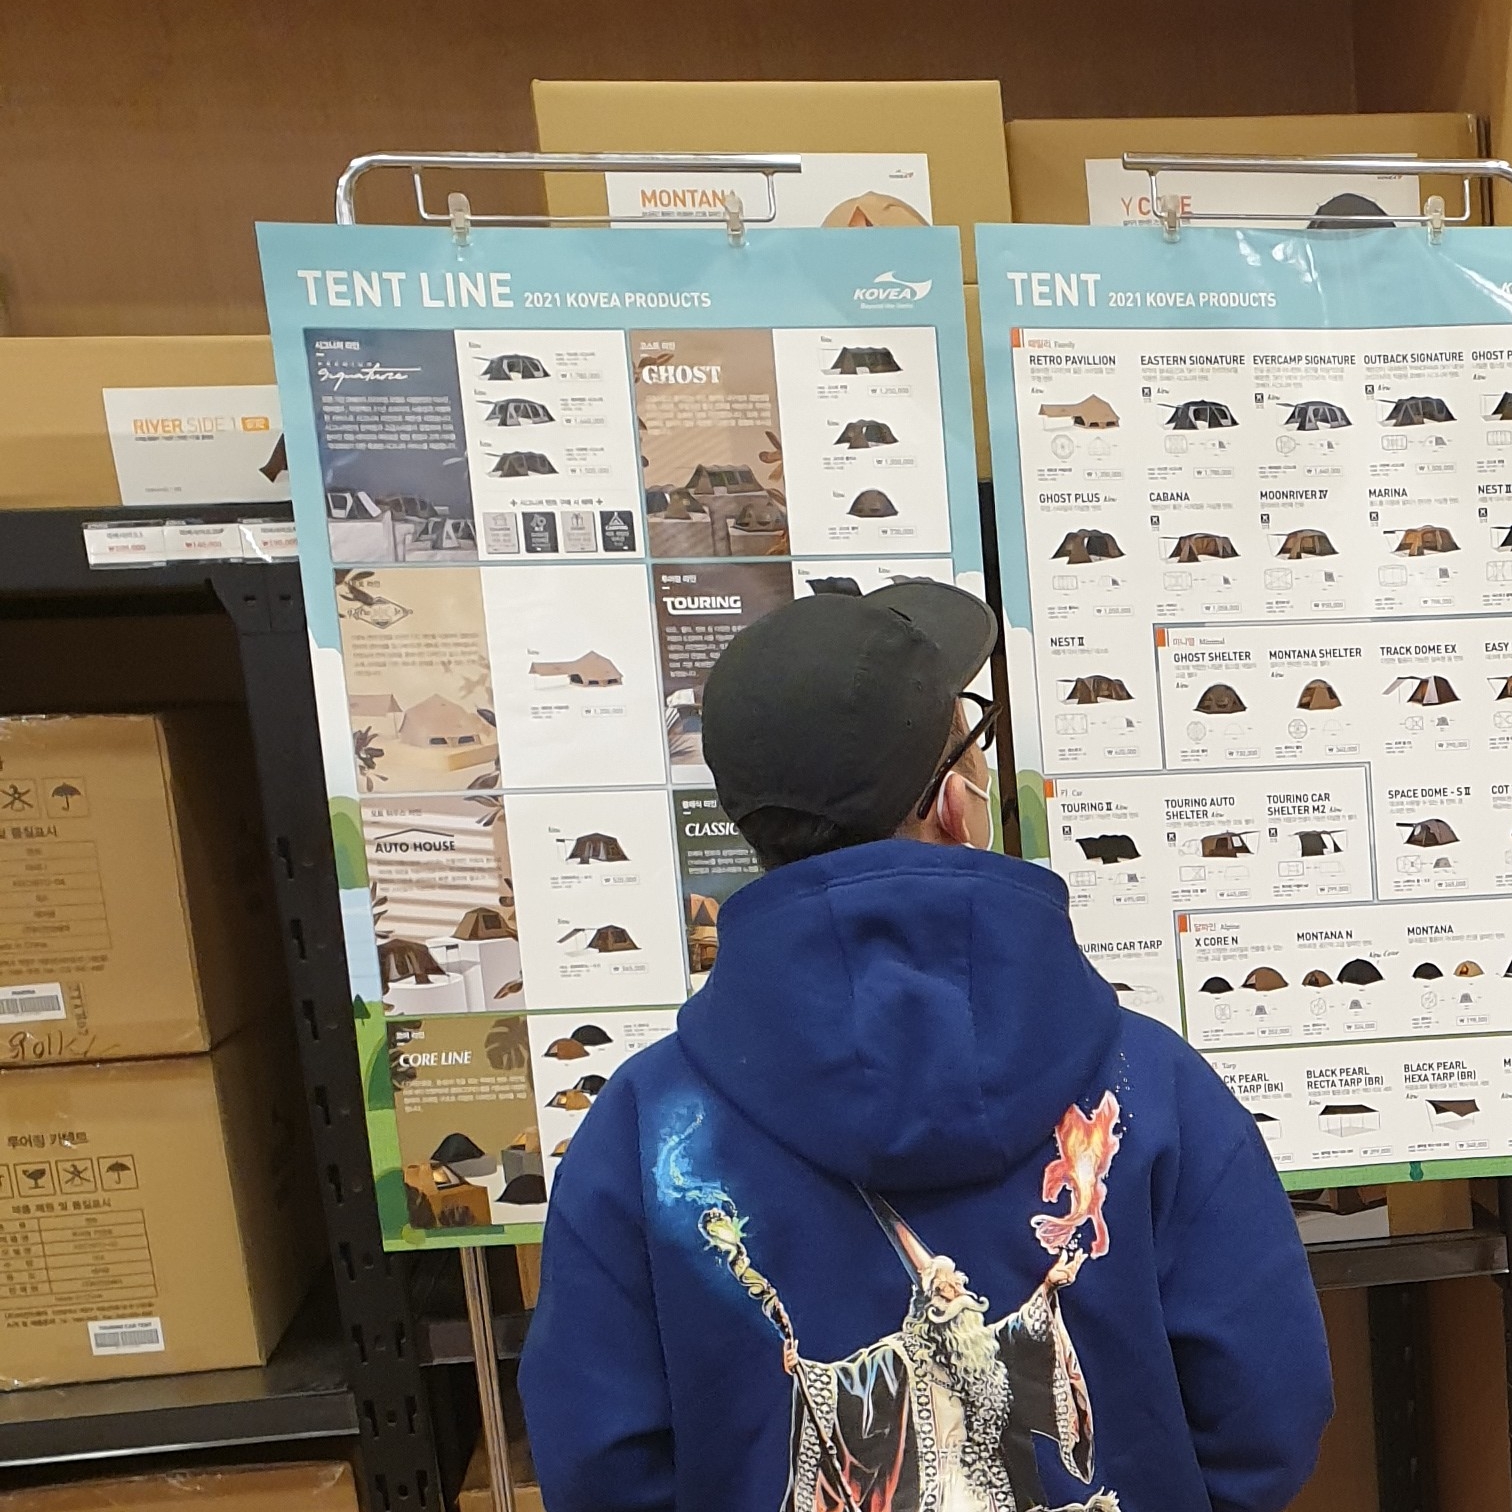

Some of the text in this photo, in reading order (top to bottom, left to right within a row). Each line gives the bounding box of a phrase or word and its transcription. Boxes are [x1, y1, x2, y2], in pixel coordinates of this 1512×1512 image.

[1121, 197, 1133, 215] Y
[297, 269, 712, 309] TENT LINE 2021 KOVEA PRODUCTS
[854, 287, 912, 301] KOVEA
[1007, 272, 1277, 308] TENT 2021 KOVEA PRODUCTS
[1029, 355, 1116, 366] RETRO PAVILLION
[1140, 354, 1246, 367] EASTERN SIGNATURE
[1252, 354, 1357, 367] EVERCAMP SIGNATURE
[1363, 351, 1464, 365] OUTBACK SIGNATURE
[1471, 349, 1504, 361] GHOST
[642, 365, 723, 385] GHOST
[133, 418, 184, 434] RIVER
[186, 417, 227, 433] SIDE
[1259, 489, 1318, 501] MOONRIVER
[1368, 488, 1408, 499] MARINA
[1477, 484, 1504, 495] NEST
[1039, 492, 1101, 504] GHOST PLUS
[1149, 491, 1190, 502] CABANA
[662, 595, 742, 615] TOURING
[1050, 636, 1076, 648] NEST
[1485, 641, 1510, 653] EASY
[1269, 647, 1363, 660] MONTANA SHELTER
[1380, 643, 1457, 657] TRACK DOME EX
[1173, 651, 1252, 663] GHOST SHELTER
[1388, 787, 1449, 800] SPACE DOME
[1491, 784, 1510, 796] COT
[1164, 796, 1236, 810] TOURING AUTO
[1267, 792, 1331, 805] TOURING CAR
[1061, 803, 1104, 814] TOURING
[1165, 809, 1209, 820] SHELTER
[1267, 804, 1327, 816] SHELTER M2
[684, 822, 740, 837] CLASSIC
[375, 839, 456, 854] AUTO HOUSE
[1296, 929, 1353, 942] MONTANA N
[1407, 924, 1454, 936] MONTANA
[1115, 939, 1163, 952] CAR TARP
[1194, 936, 1239, 948] X CORE N
[398, 1050, 472, 1068] CORE LINE
[1306, 1065, 1370, 1080] BLACK PEARL
[1403, 1060, 1467, 1073] BLACK PEARL
[1238, 1073, 1270, 1084] PEARL
[1306, 1075, 1384, 1090] RECTA TARP (BR)
[1404, 1069, 1477, 1084] HEXA TARP (BR)
[1237, 1081, 1284, 1093] TARP (BK)
